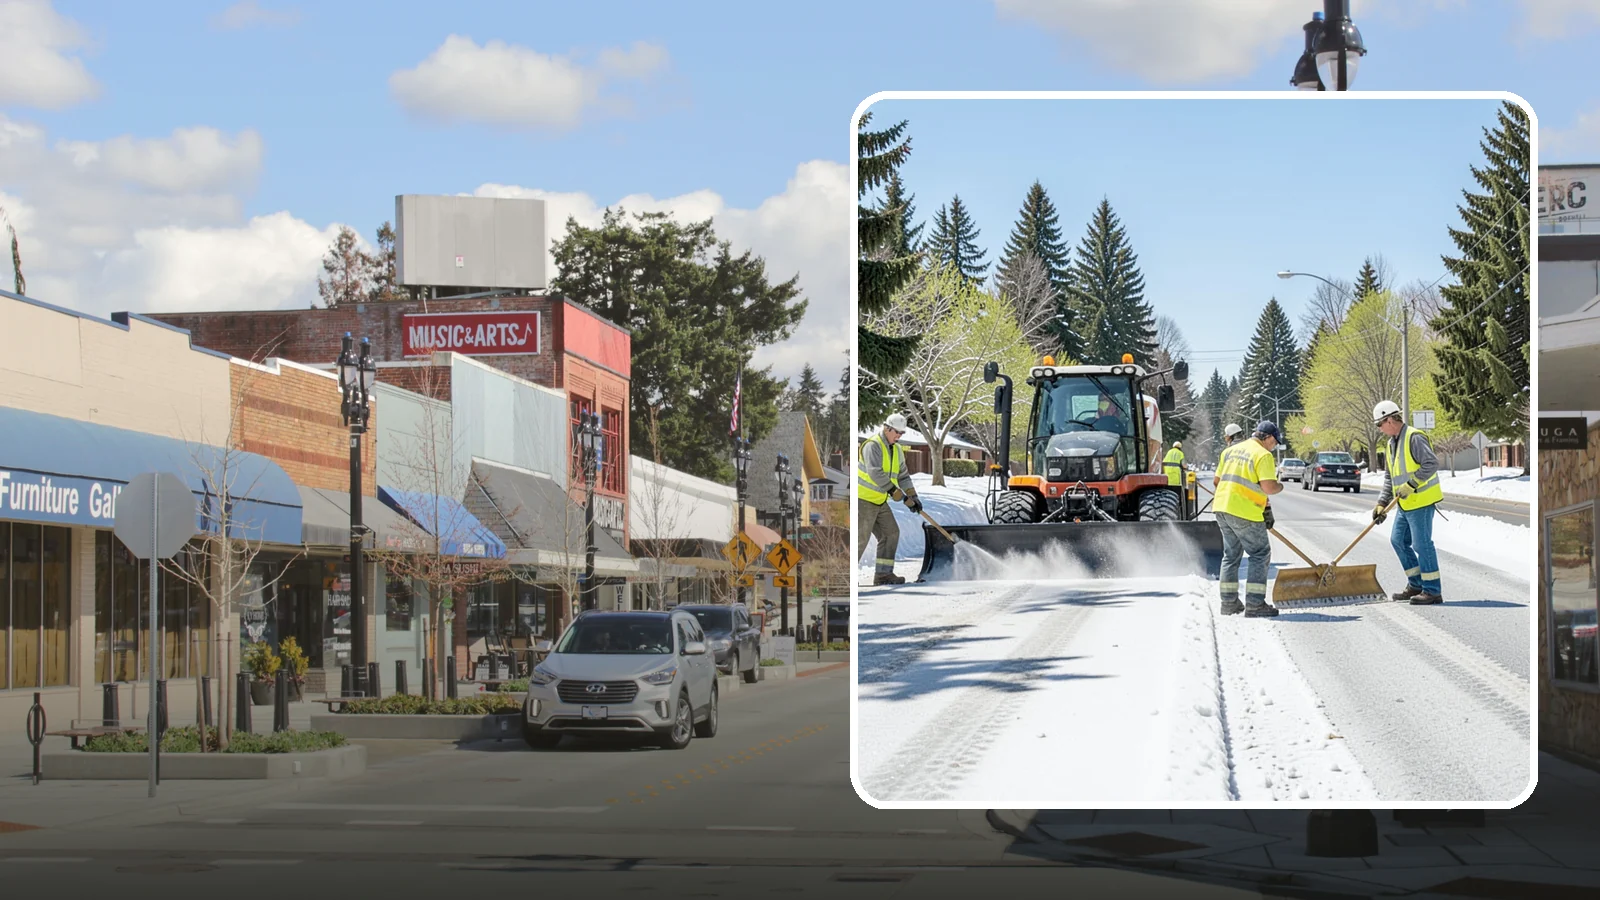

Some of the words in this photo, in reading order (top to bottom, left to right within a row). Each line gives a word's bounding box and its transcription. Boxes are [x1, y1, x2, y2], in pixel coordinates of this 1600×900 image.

[409, 323, 519, 349] MUSIC&ARTS
[0, 471, 80, 515] Furniture
[89, 482, 121, 519] Gal
[452, 562, 480, 575] SUSHI
